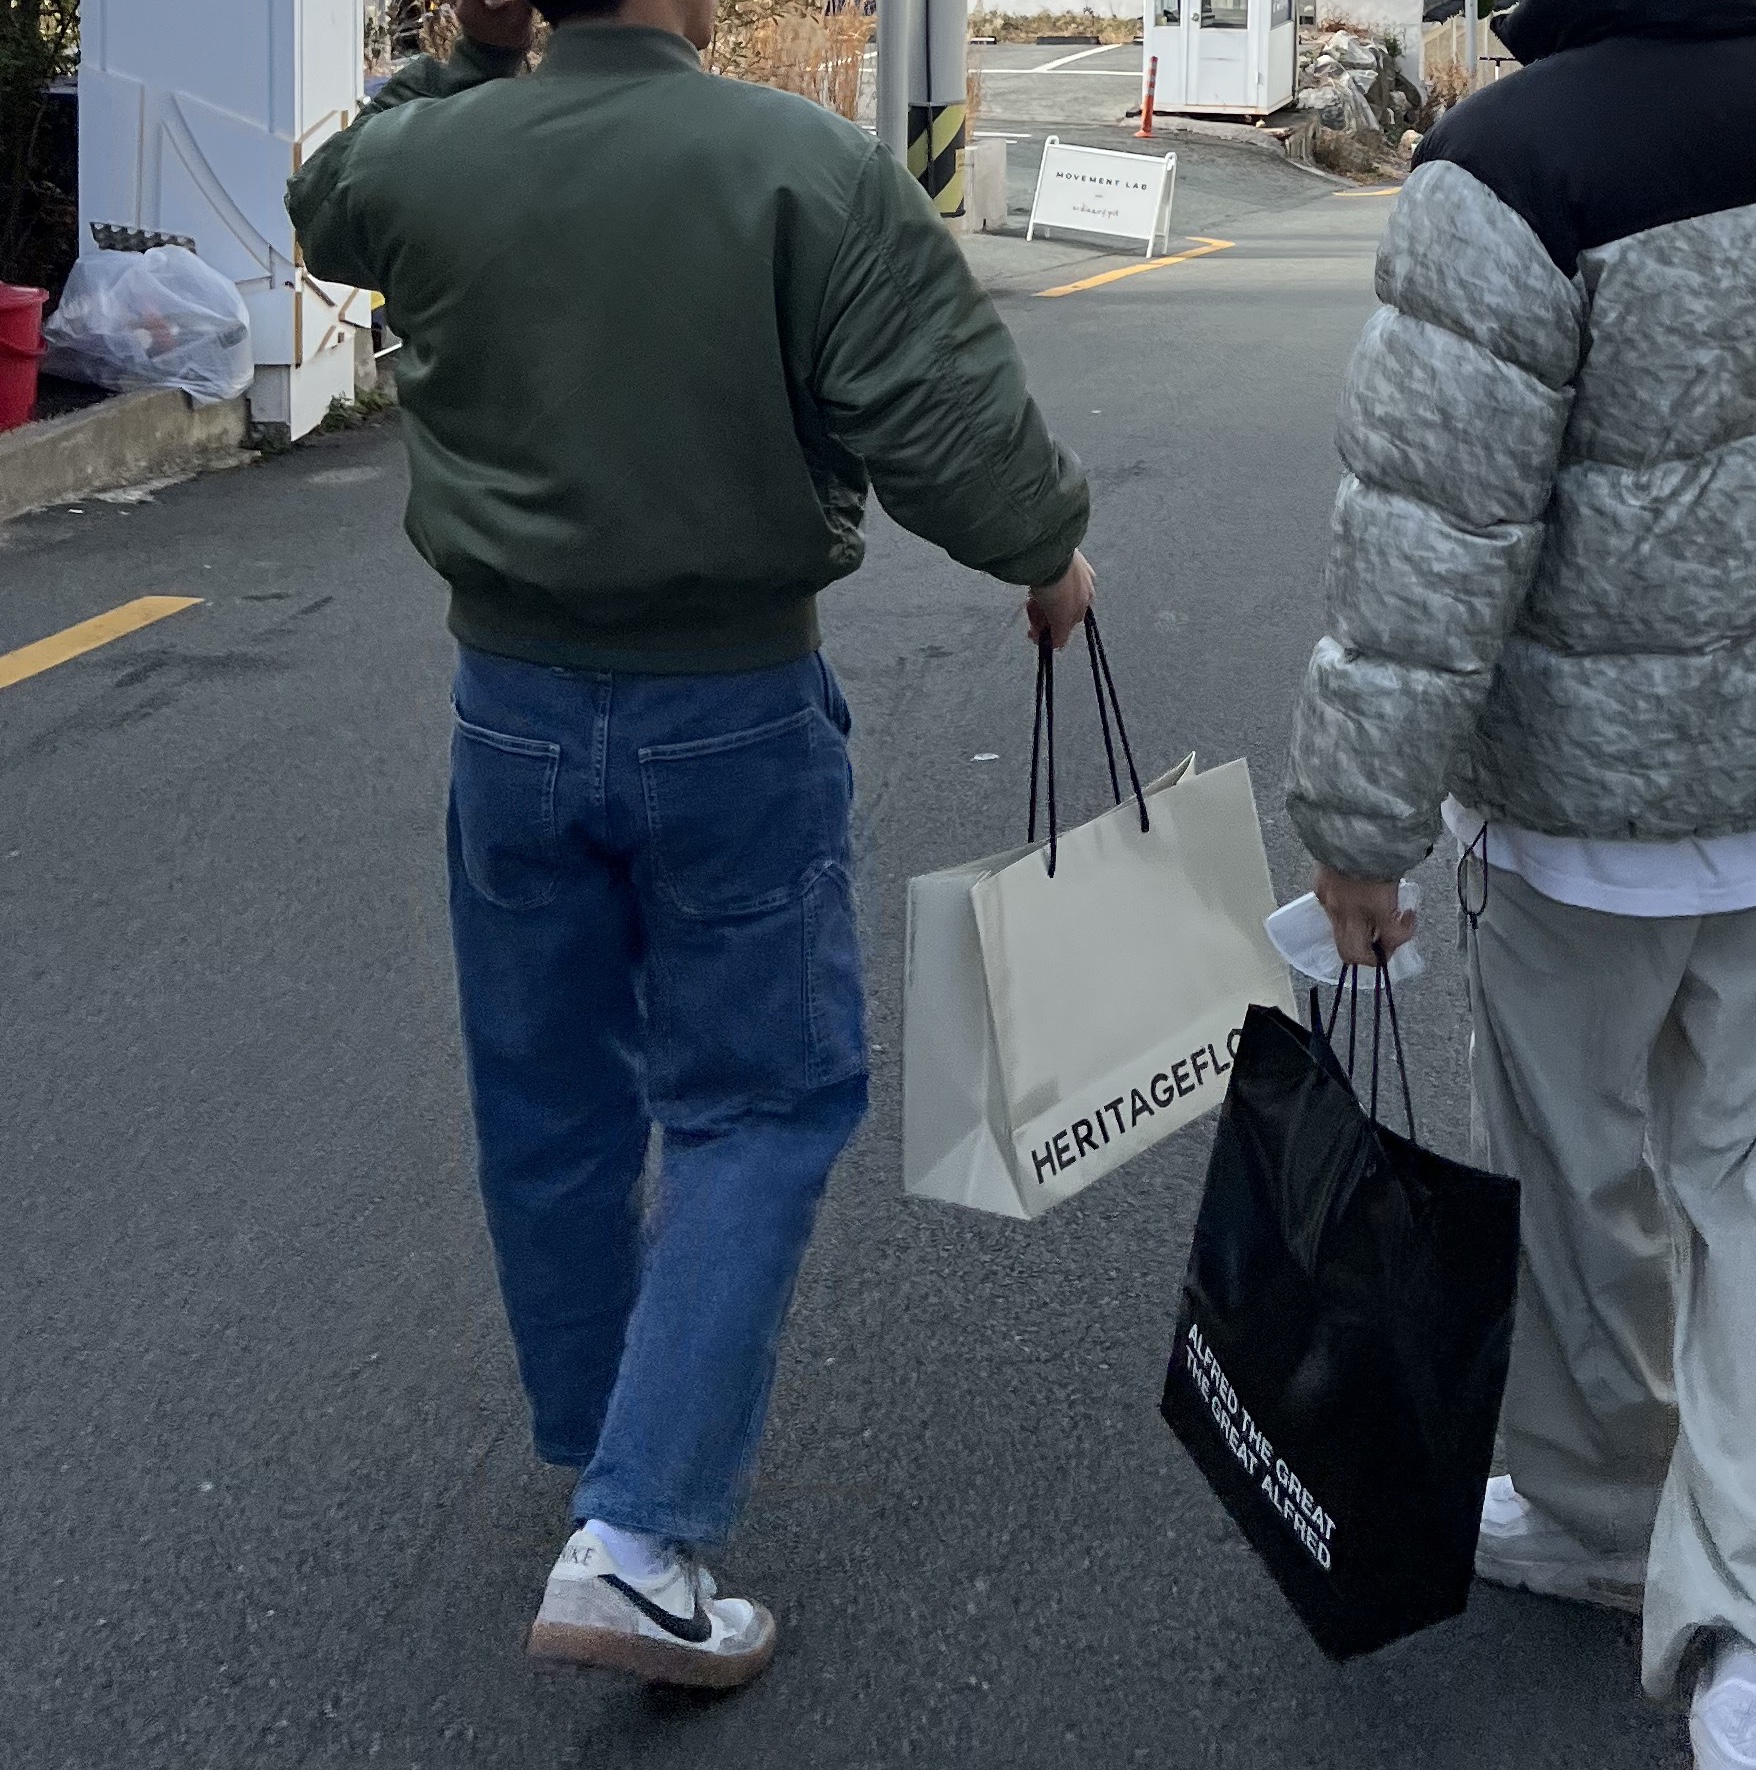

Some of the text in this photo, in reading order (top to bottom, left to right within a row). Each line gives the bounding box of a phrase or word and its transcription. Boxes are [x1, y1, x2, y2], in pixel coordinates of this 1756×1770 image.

[1056, 171, 1148, 191] MOVEMENT LAB
[1186, 1344, 1331, 1569] THE GREAT ALFRED
[1188, 1323, 1336, 1540] ALFRED THE GREAT
